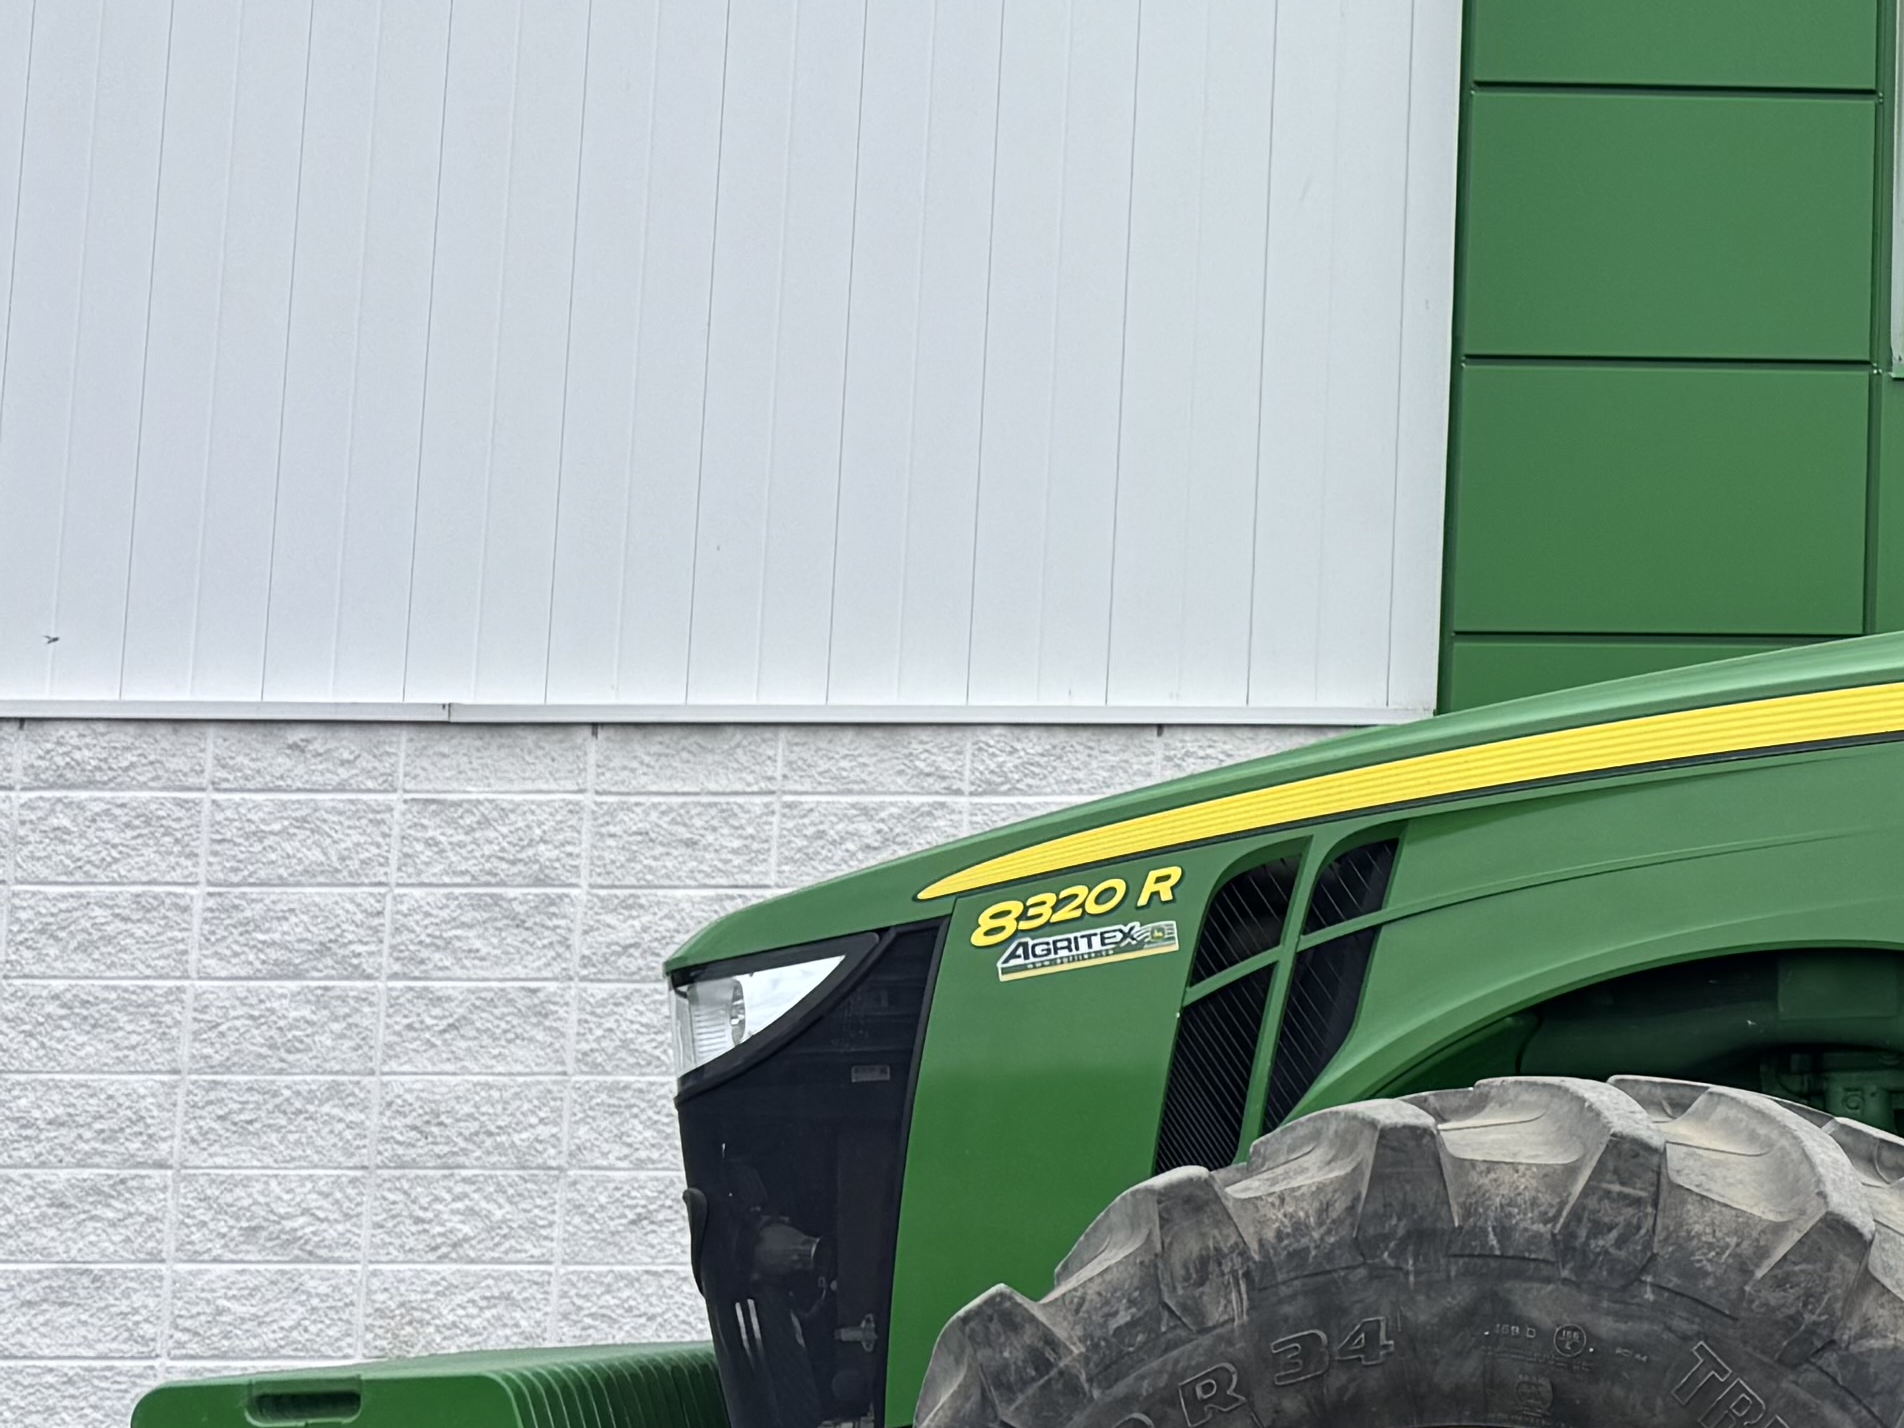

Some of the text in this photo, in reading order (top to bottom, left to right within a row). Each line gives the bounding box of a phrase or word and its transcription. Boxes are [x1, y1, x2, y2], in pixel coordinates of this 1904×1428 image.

[969, 864, 1184, 948] 8320 R
[1001, 926, 1138, 965] AGRITEX
[1176, 1362, 1247, 1428] R
[1271, 1316, 1395, 1386] 34
